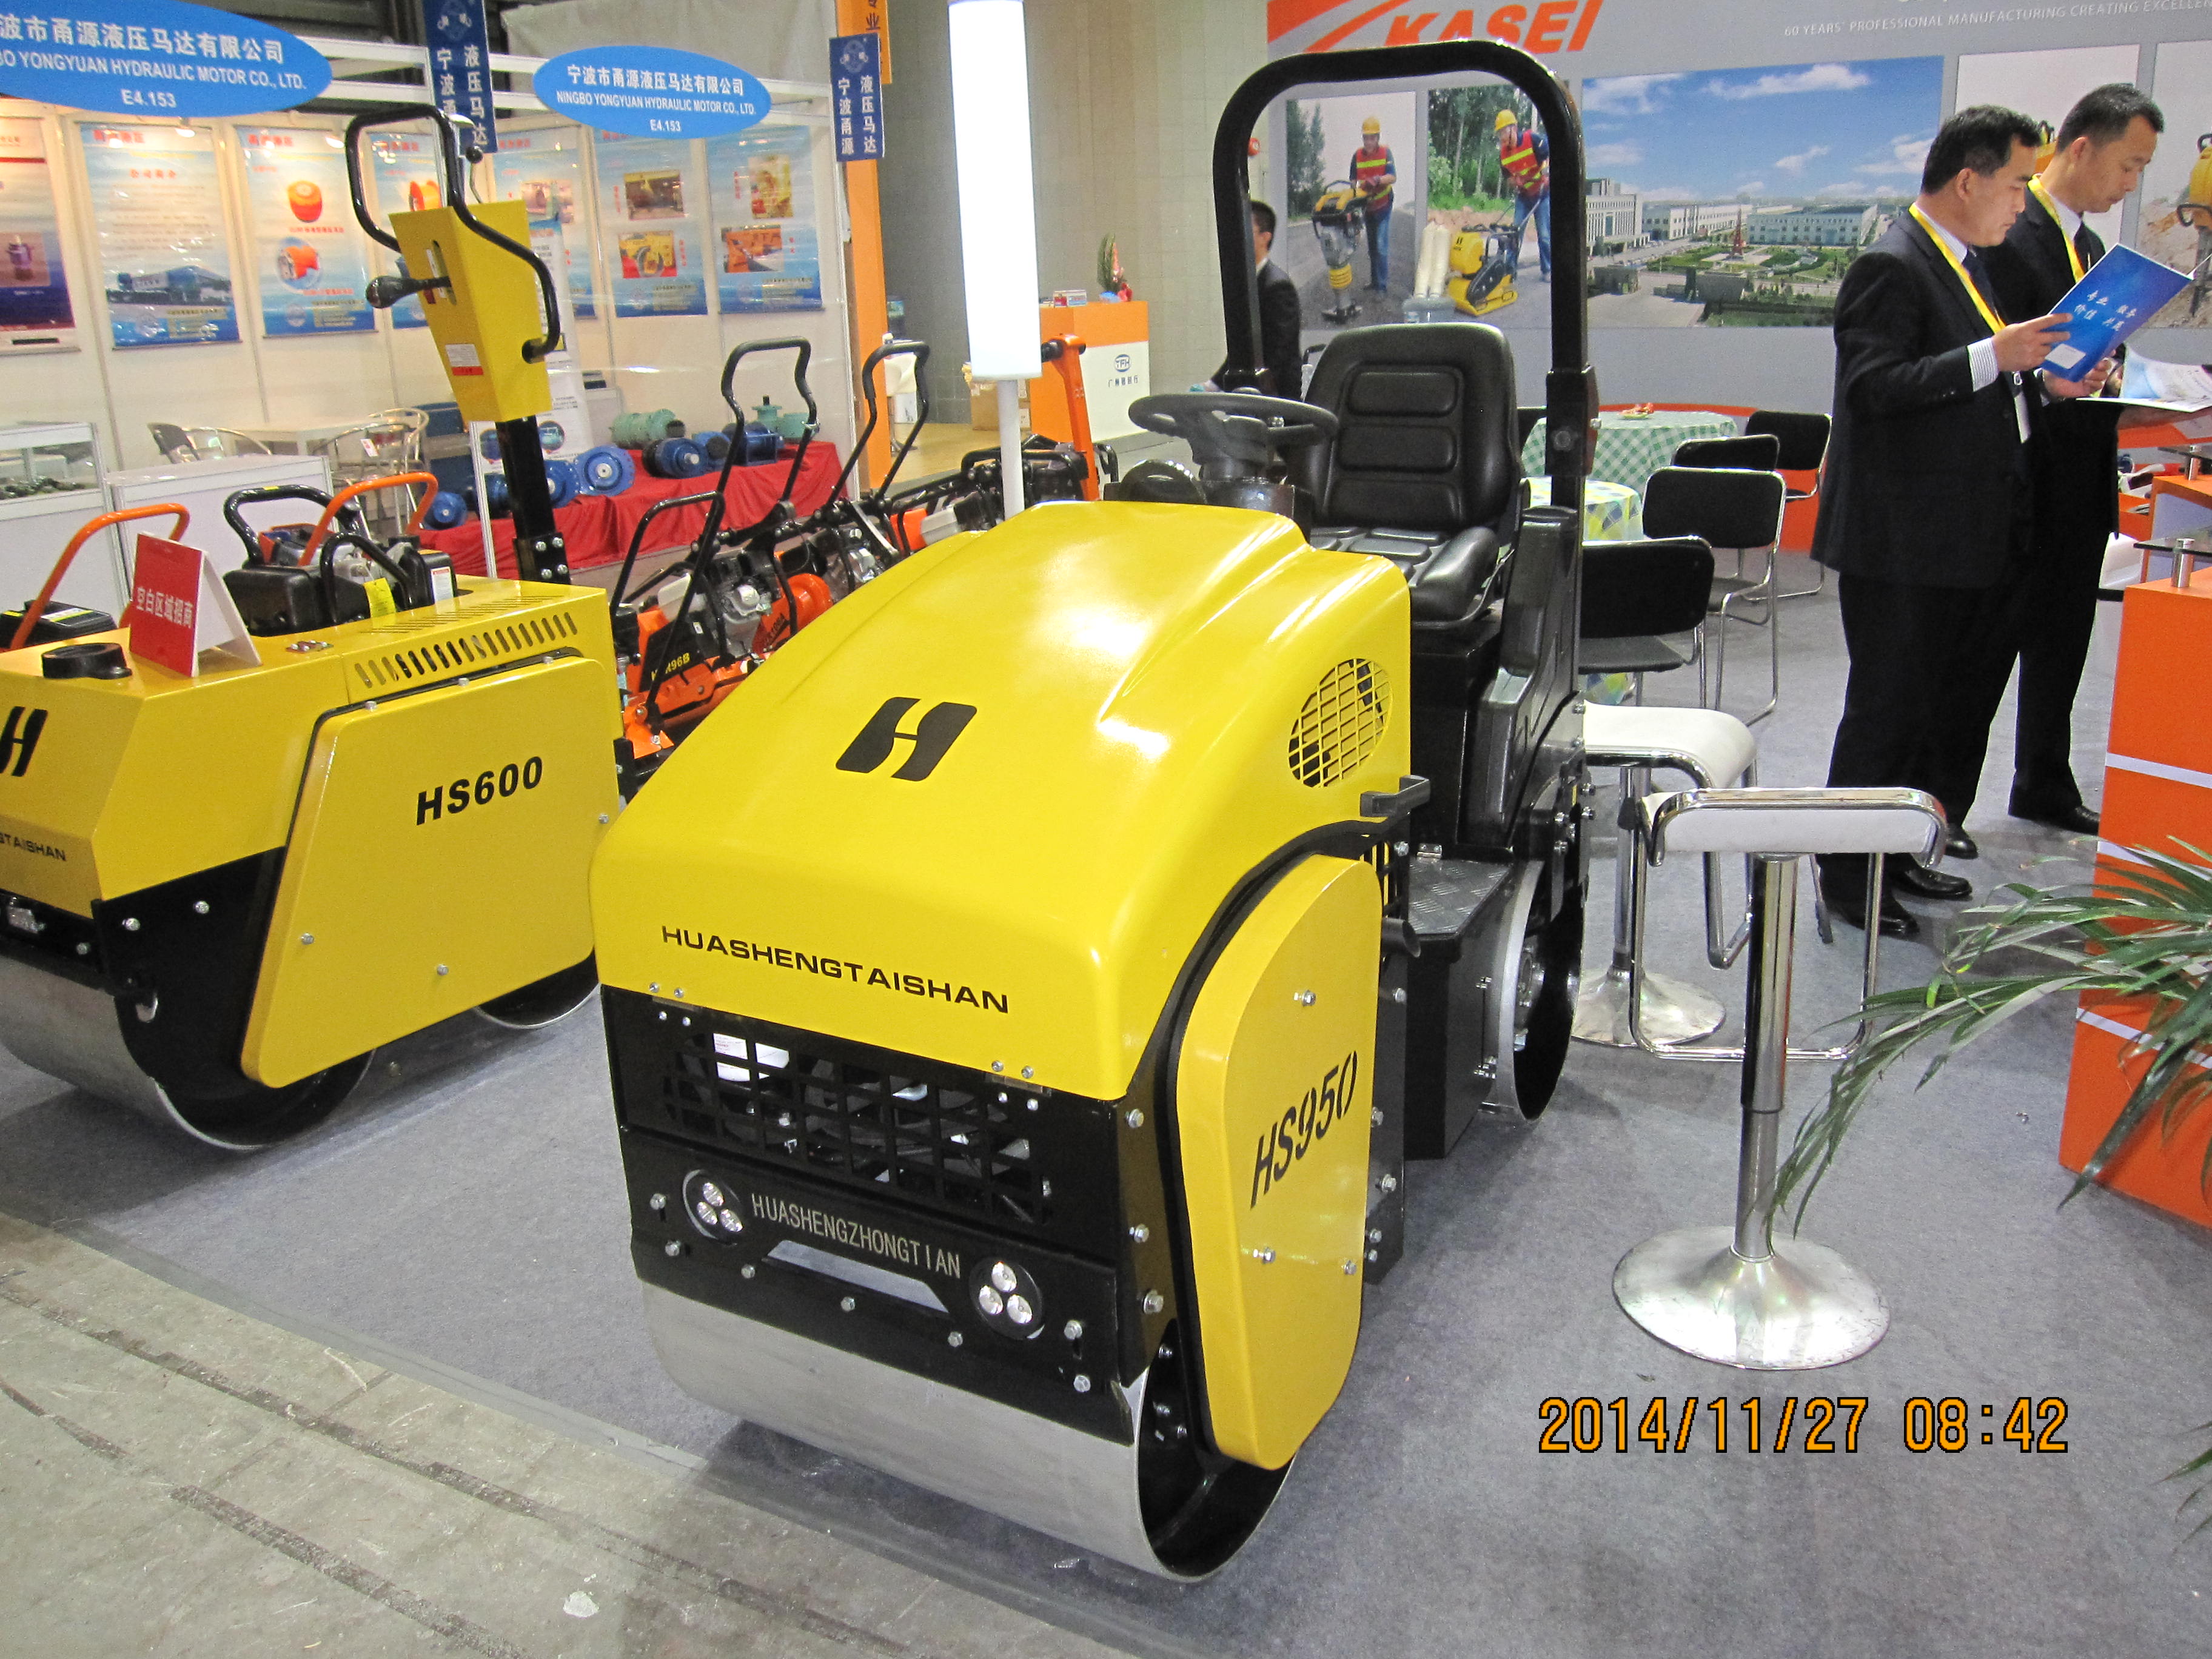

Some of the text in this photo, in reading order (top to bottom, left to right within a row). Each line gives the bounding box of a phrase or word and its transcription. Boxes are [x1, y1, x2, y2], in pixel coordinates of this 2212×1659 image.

[1384, 0, 1604, 54] KASEI
[1849, 16, 1942, 32] PROFESSIONAL
[1948, 6, 2066, 25] MANUFACTURING
[2070, 2, 2138, 16] CREATING
[18, 51, 109, 73] YONGYUAN
[111, 59, 195, 81] HYDRAULIC
[197, 65, 247, 85] MOTOR
[249, 70, 276, 89] CO.,
[278, 73, 307, 89] LTD.
[121, 89, 176, 108] E4.153
[556, 89, 756, 115] NINGBO YONGYUAN HYDRAULIC MOTOR CO., LTD.
[650, 119, 682, 132] E4.153
[838, 78, 854, 155] 宁波甬源
[860, 75, 877, 153] 液压马达
[417, 756, 543, 826] HS600
[662, 925, 1008, 1014] HUASHENGTAISHAN
[1250, 1050, 1358, 1210] HS950
[751, 1193, 960, 1279] HUASHENGZHONGTIAN
